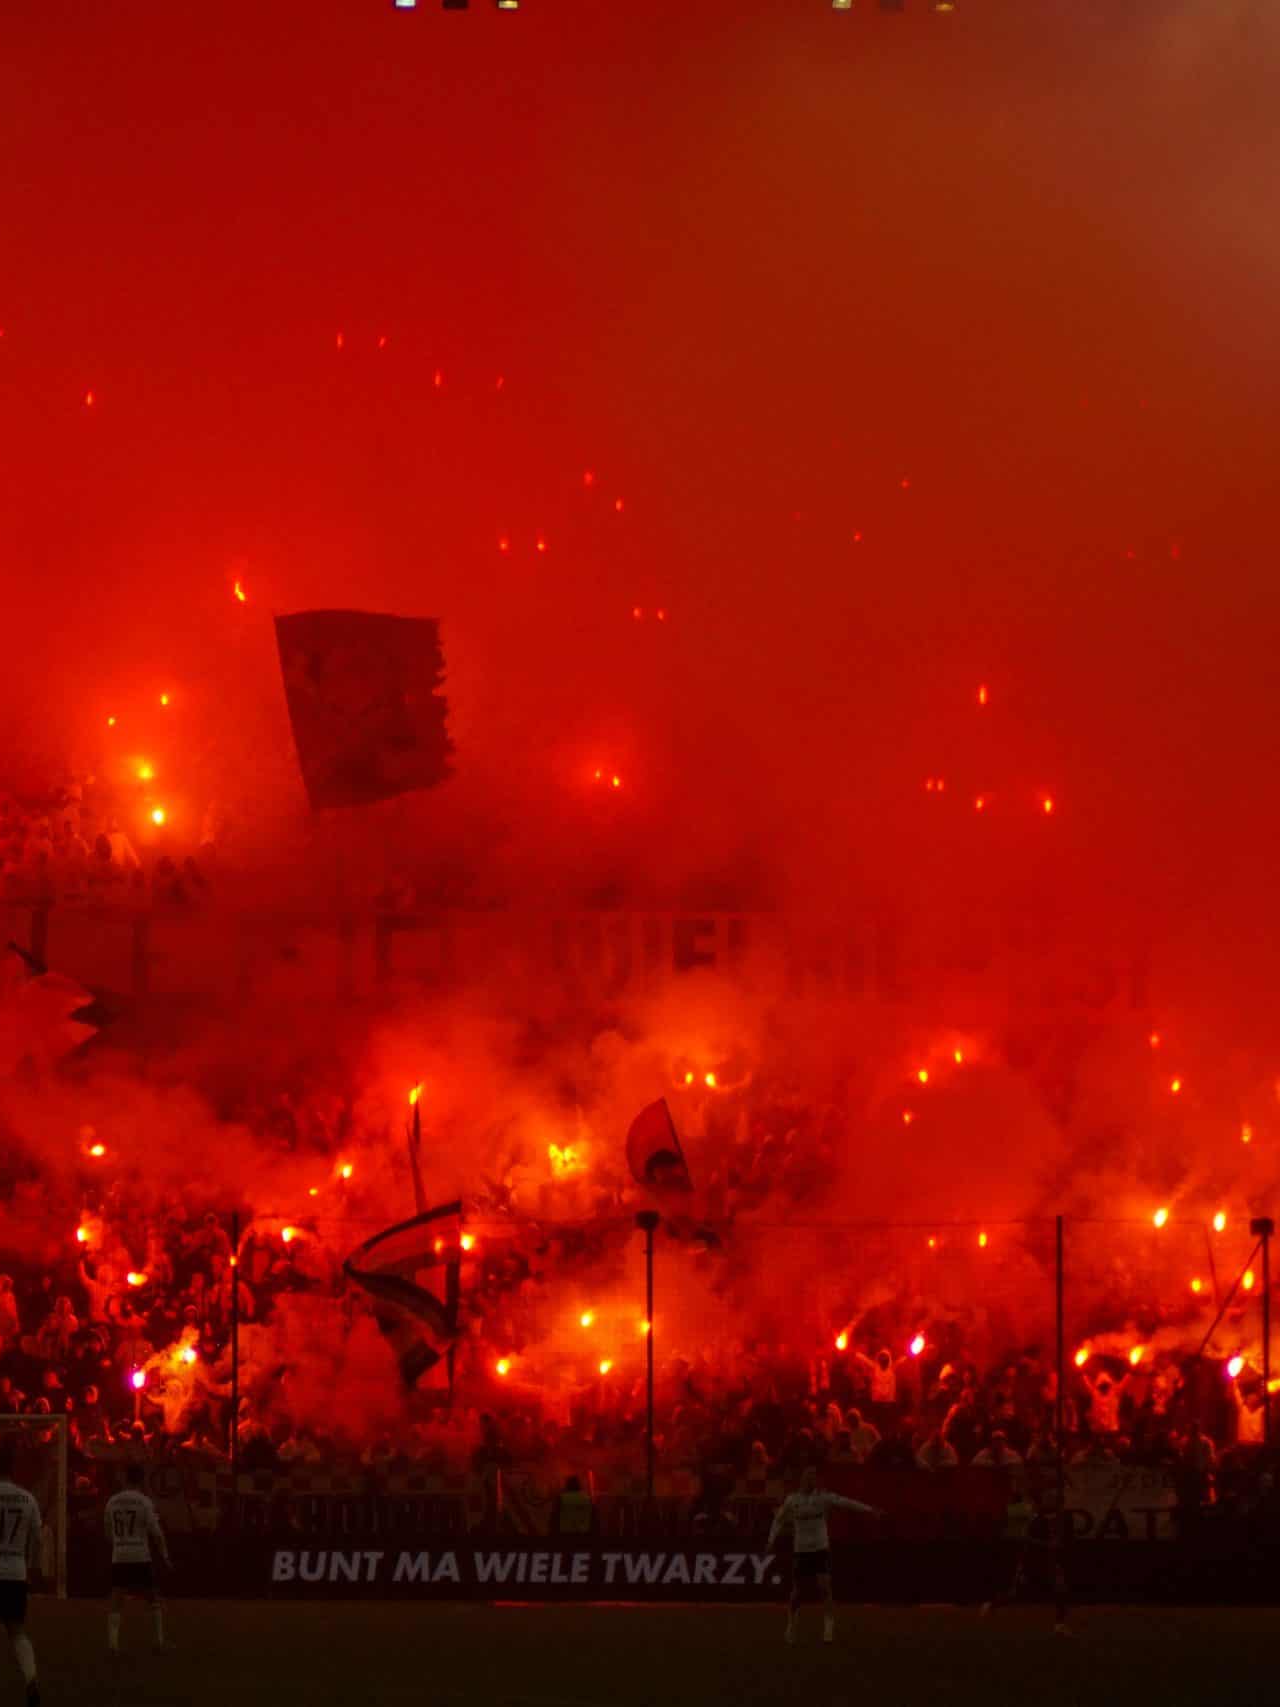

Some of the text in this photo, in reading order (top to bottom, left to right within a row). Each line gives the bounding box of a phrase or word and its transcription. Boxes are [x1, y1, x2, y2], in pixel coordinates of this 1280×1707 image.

[113, 1509, 138, 1537] 67
[273, 1551, 783, 1585] BUNT MA WIELE TWARZY.
